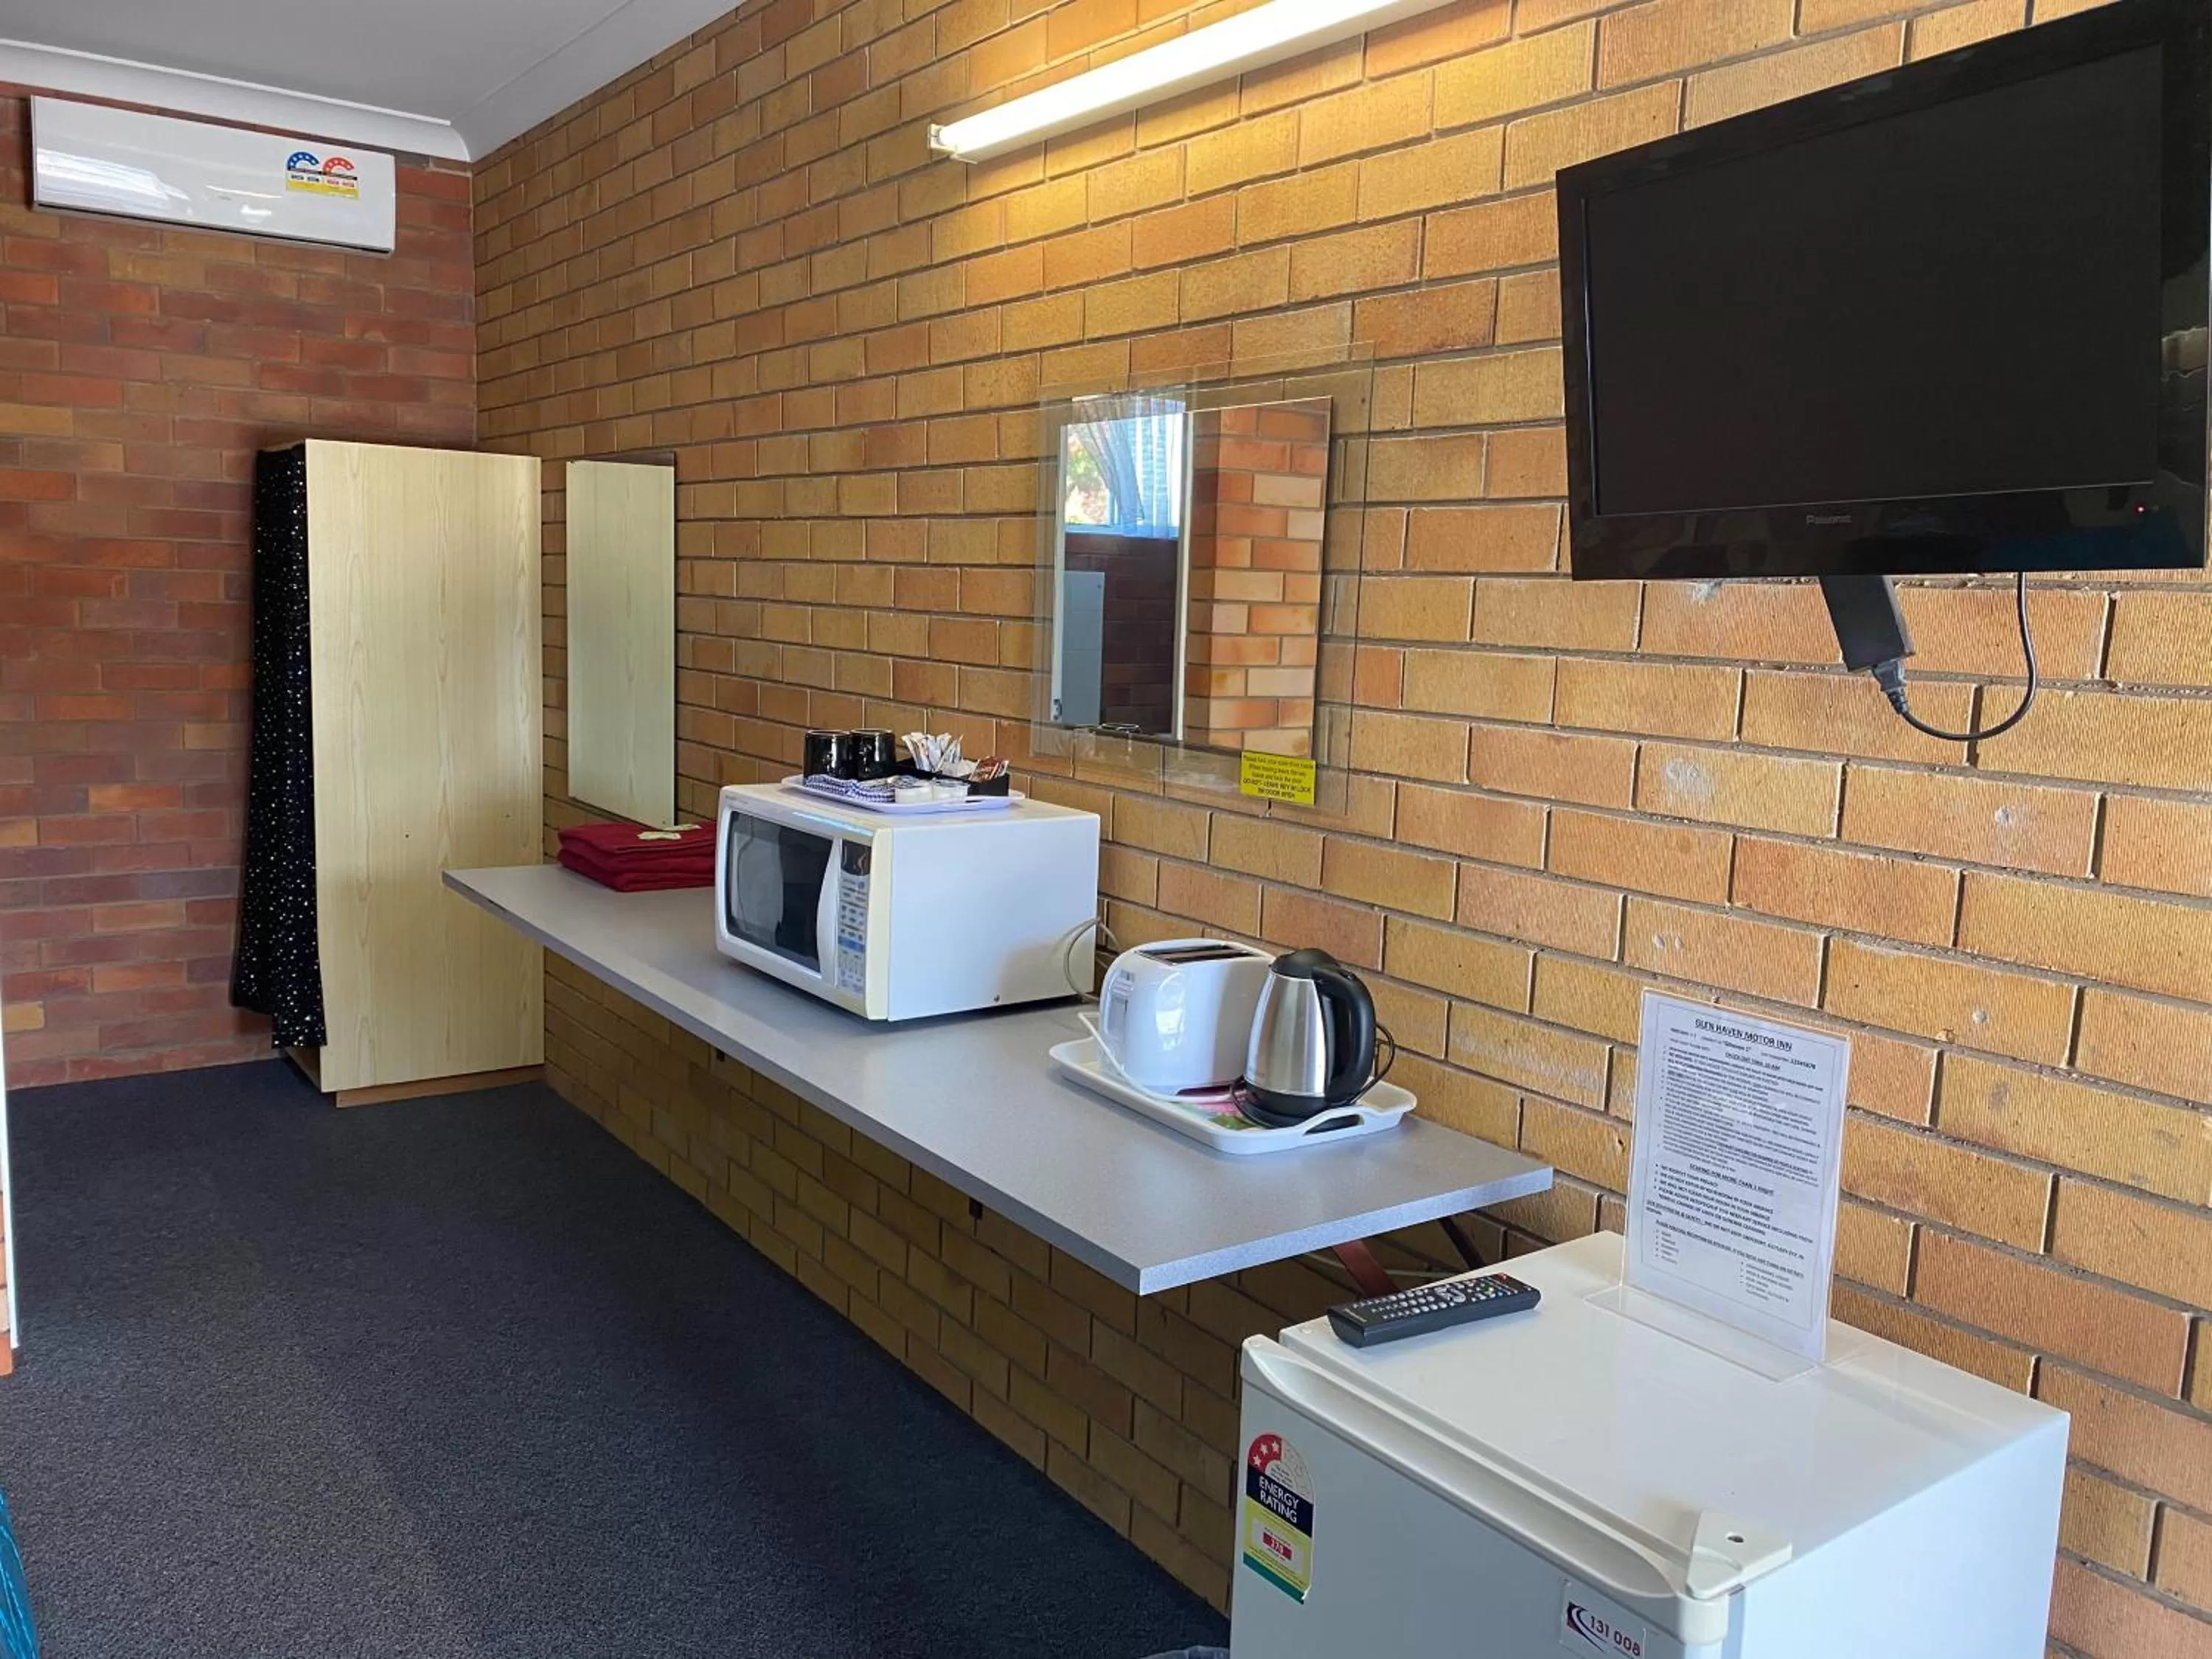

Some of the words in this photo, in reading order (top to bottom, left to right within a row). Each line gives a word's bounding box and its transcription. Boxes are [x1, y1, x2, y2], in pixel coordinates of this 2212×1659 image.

[1715, 1023, 1744, 1038] HAVEN
[1744, 1031, 1775, 1046] MOTOR
[1775, 1039, 1792, 1051] INN
[1259, 1476, 1299, 1509] ENERGY
[1260, 1490, 1298, 1523] RATING
[1590, 1615, 1610, 1637] 131
[1614, 1630, 1641, 1656] 008
